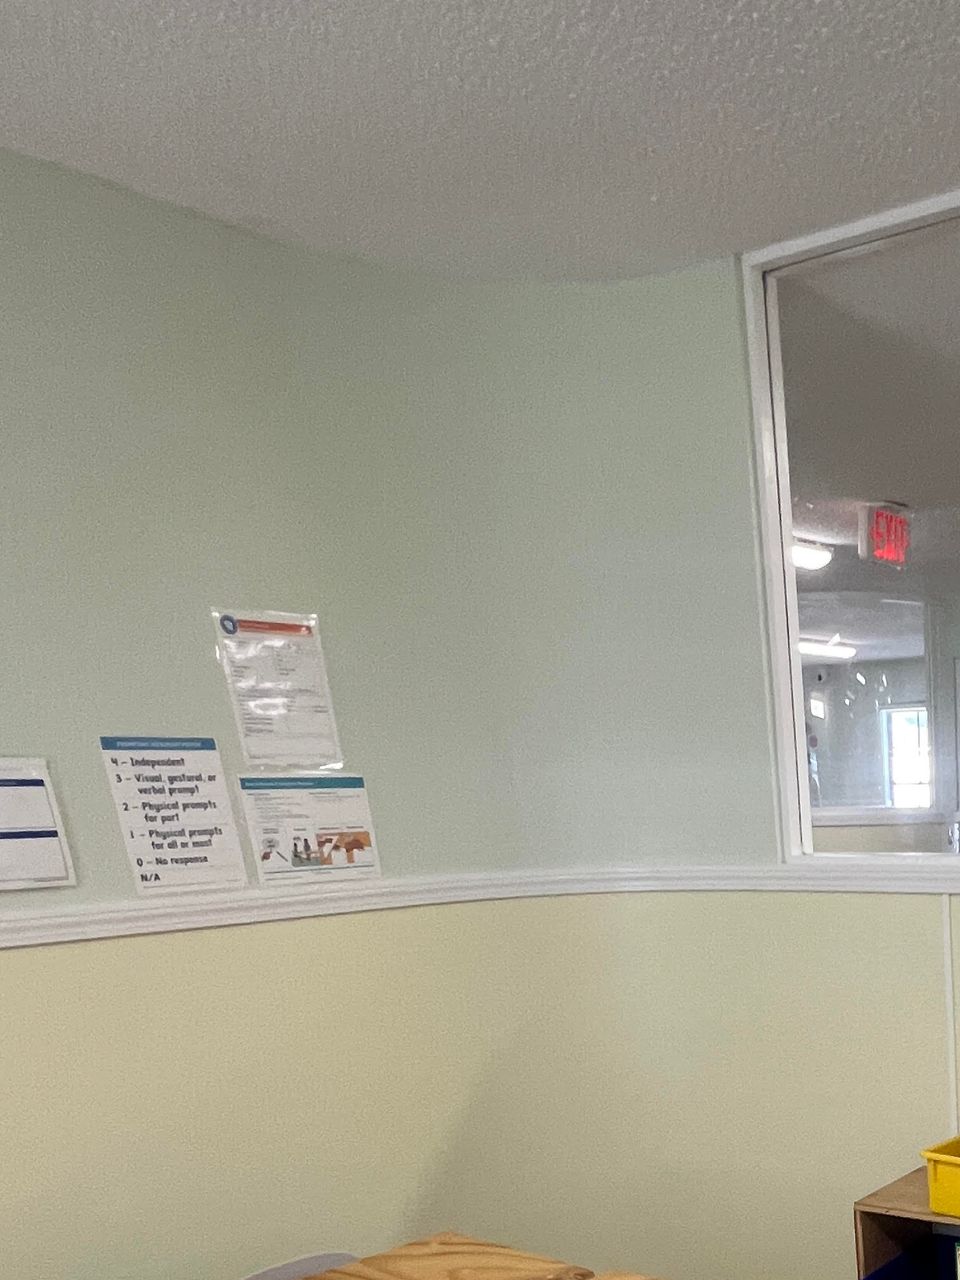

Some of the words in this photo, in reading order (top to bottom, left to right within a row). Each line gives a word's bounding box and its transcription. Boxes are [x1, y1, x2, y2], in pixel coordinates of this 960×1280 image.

[111, 757, 118, 766] 4
[130, 757, 185, 769] Independent
[116, 774, 123, 783] 3
[138, 785, 166, 795] verbal
[168, 785, 199, 796] prompt
[123, 803, 129, 811] 2
[142, 801, 179, 813] Physical
[182, 800, 217, 812] prompts
[144, 814, 159, 822] for
[161, 813, 179, 824] part
[148, 828, 186, 840] Physical
[189, 827, 222, 839] prompts
[151, 841, 164, 849] for
[167, 840, 178, 849] all
[192, 839, 212, 848] most
[136, 858, 143, 867] 0
[155, 857, 168, 865] No
[170, 855, 209, 866] response
[140, 873, 161, 882] N/A
